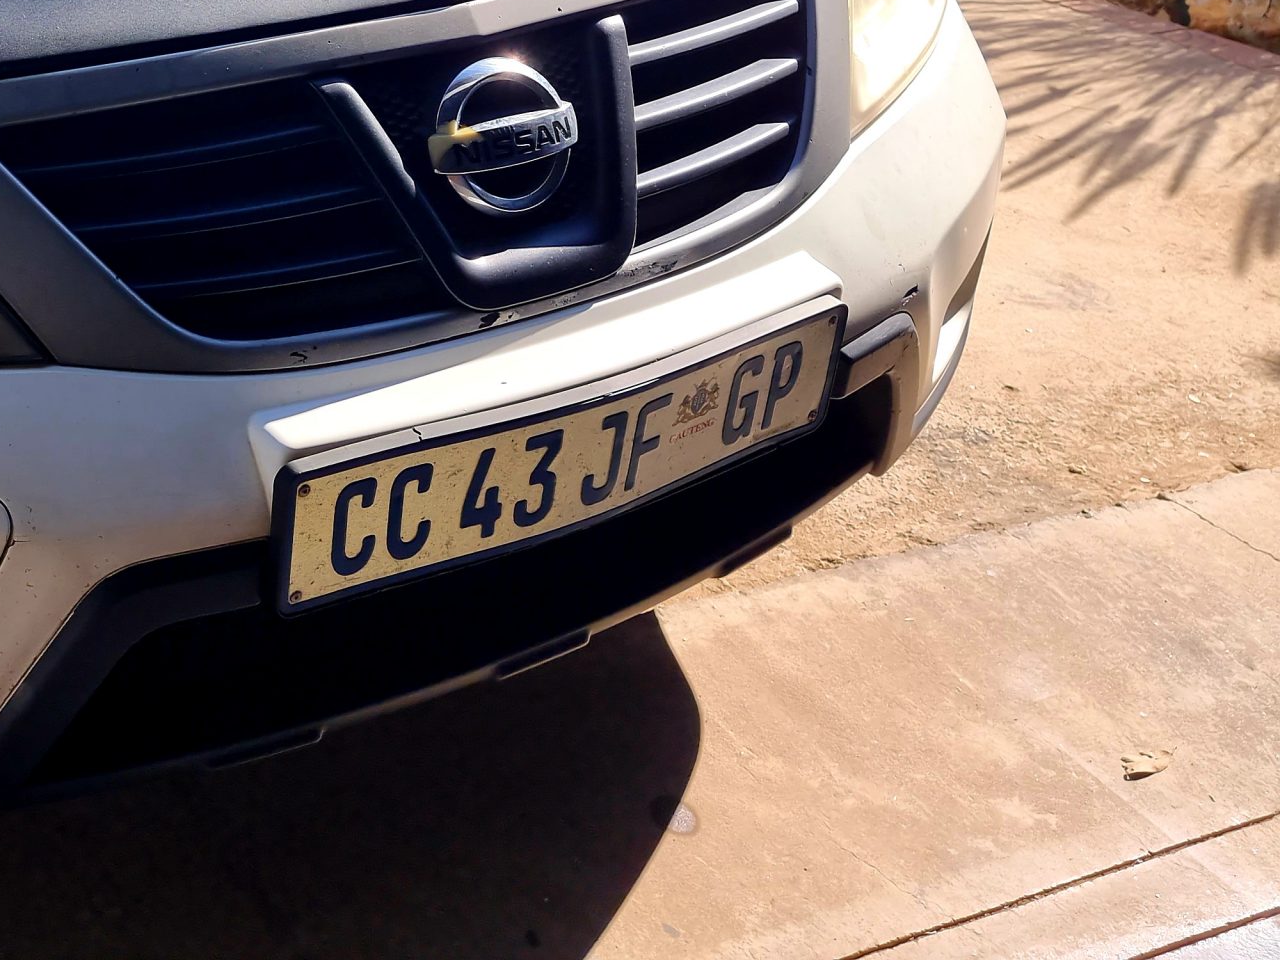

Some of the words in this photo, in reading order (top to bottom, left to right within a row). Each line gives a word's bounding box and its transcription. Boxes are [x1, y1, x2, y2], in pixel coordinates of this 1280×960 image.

[454, 116, 572, 166] NISSAN
[330, 462, 434, 577] CC
[459, 429, 565, 539] 43
[580, 392, 674, 506] JF
[721, 340, 804, 447] GP
